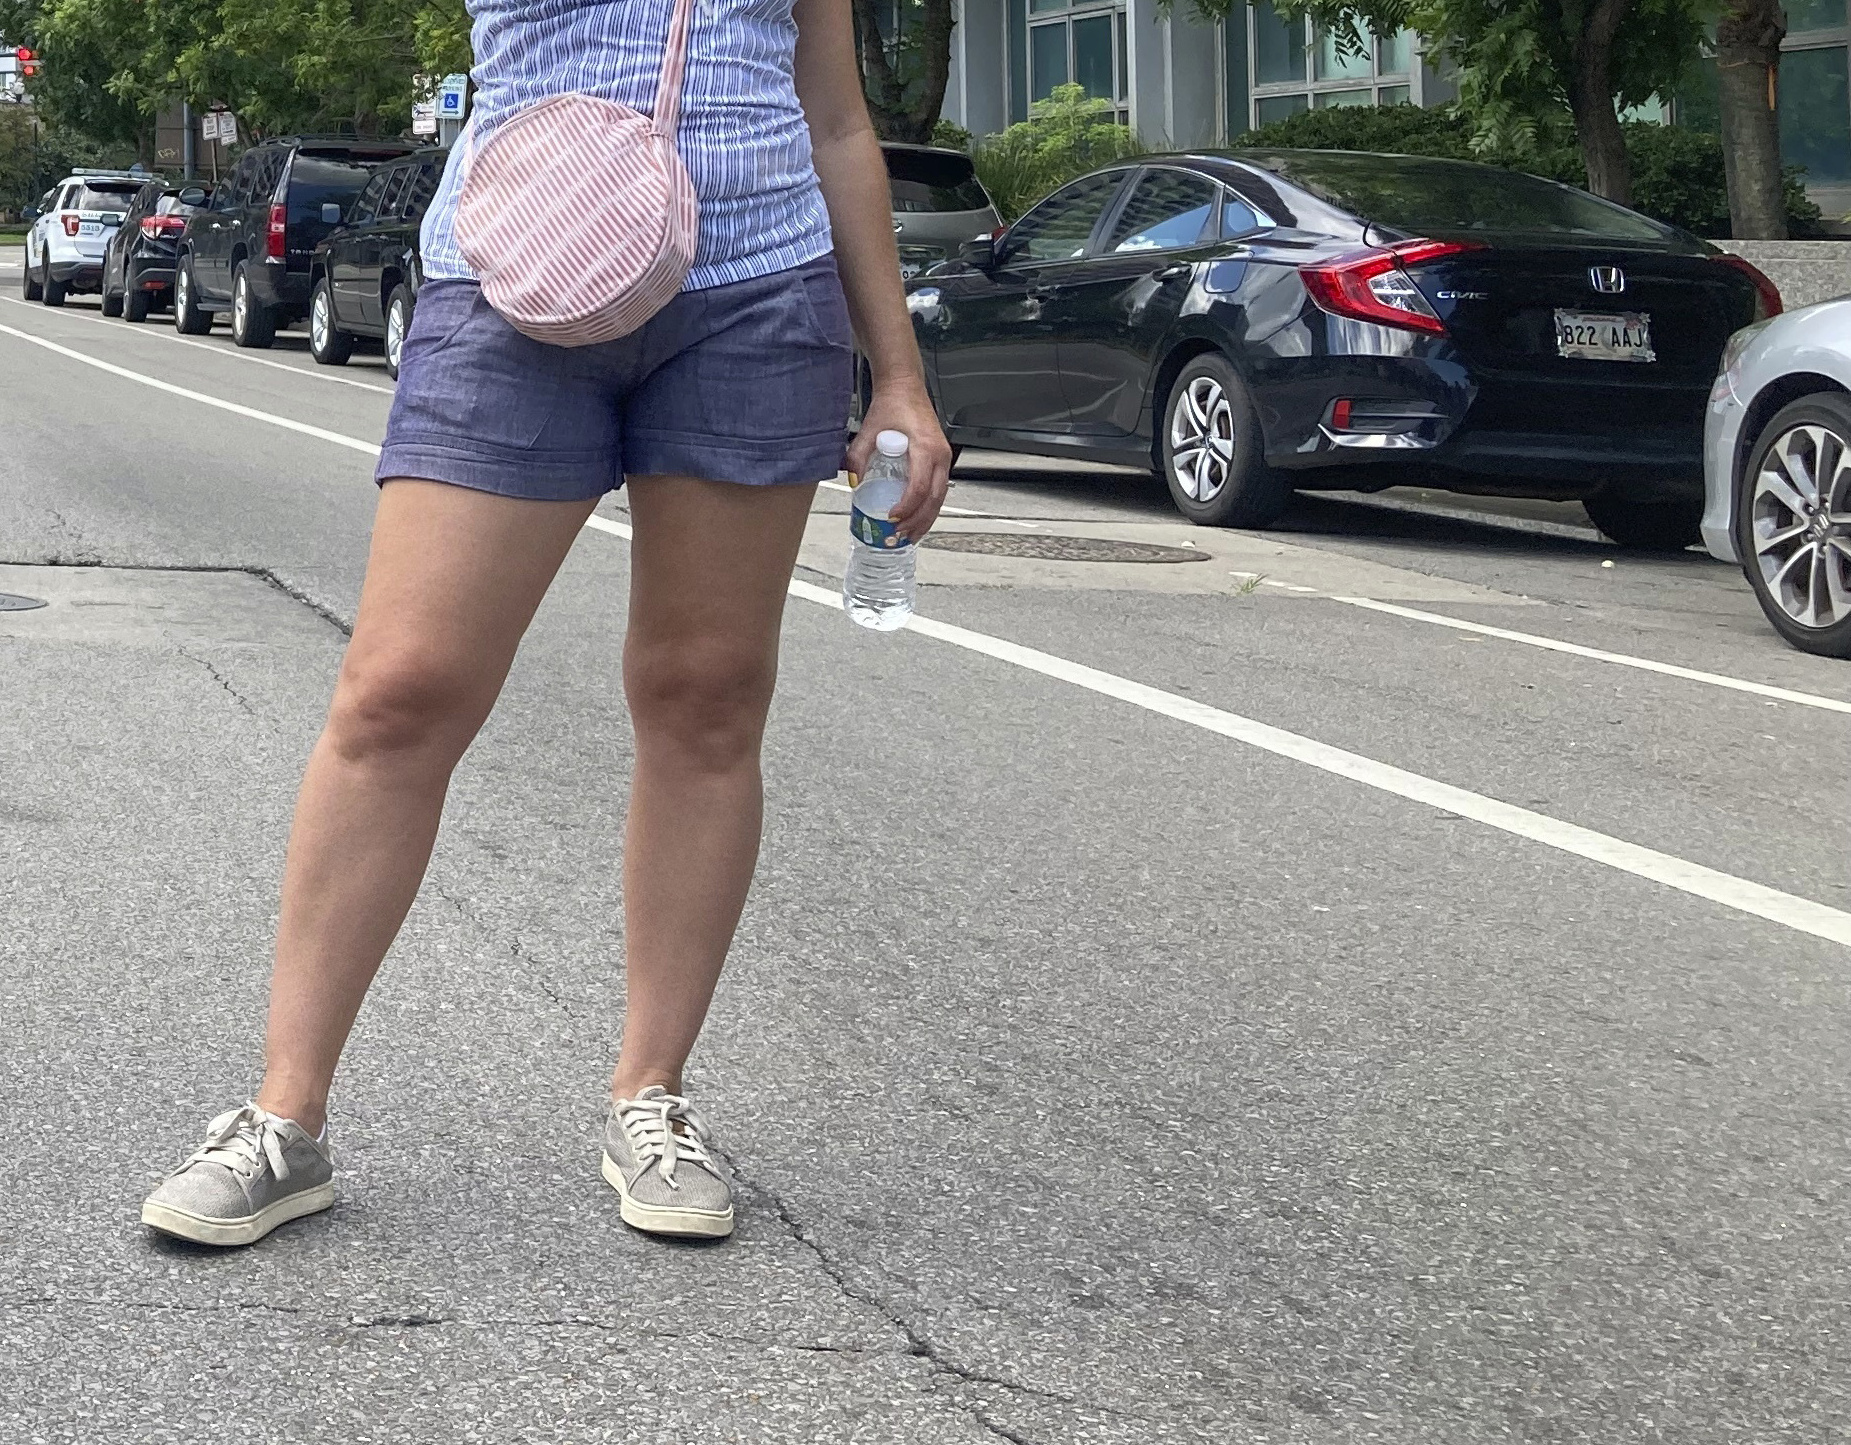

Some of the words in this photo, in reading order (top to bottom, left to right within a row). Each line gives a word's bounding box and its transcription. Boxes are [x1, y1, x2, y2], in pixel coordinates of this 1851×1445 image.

[1436, 291, 1490, 300] CIVIC
[1564, 324, 1598, 346] 822
[1611, 326, 1644, 348] AAJ
